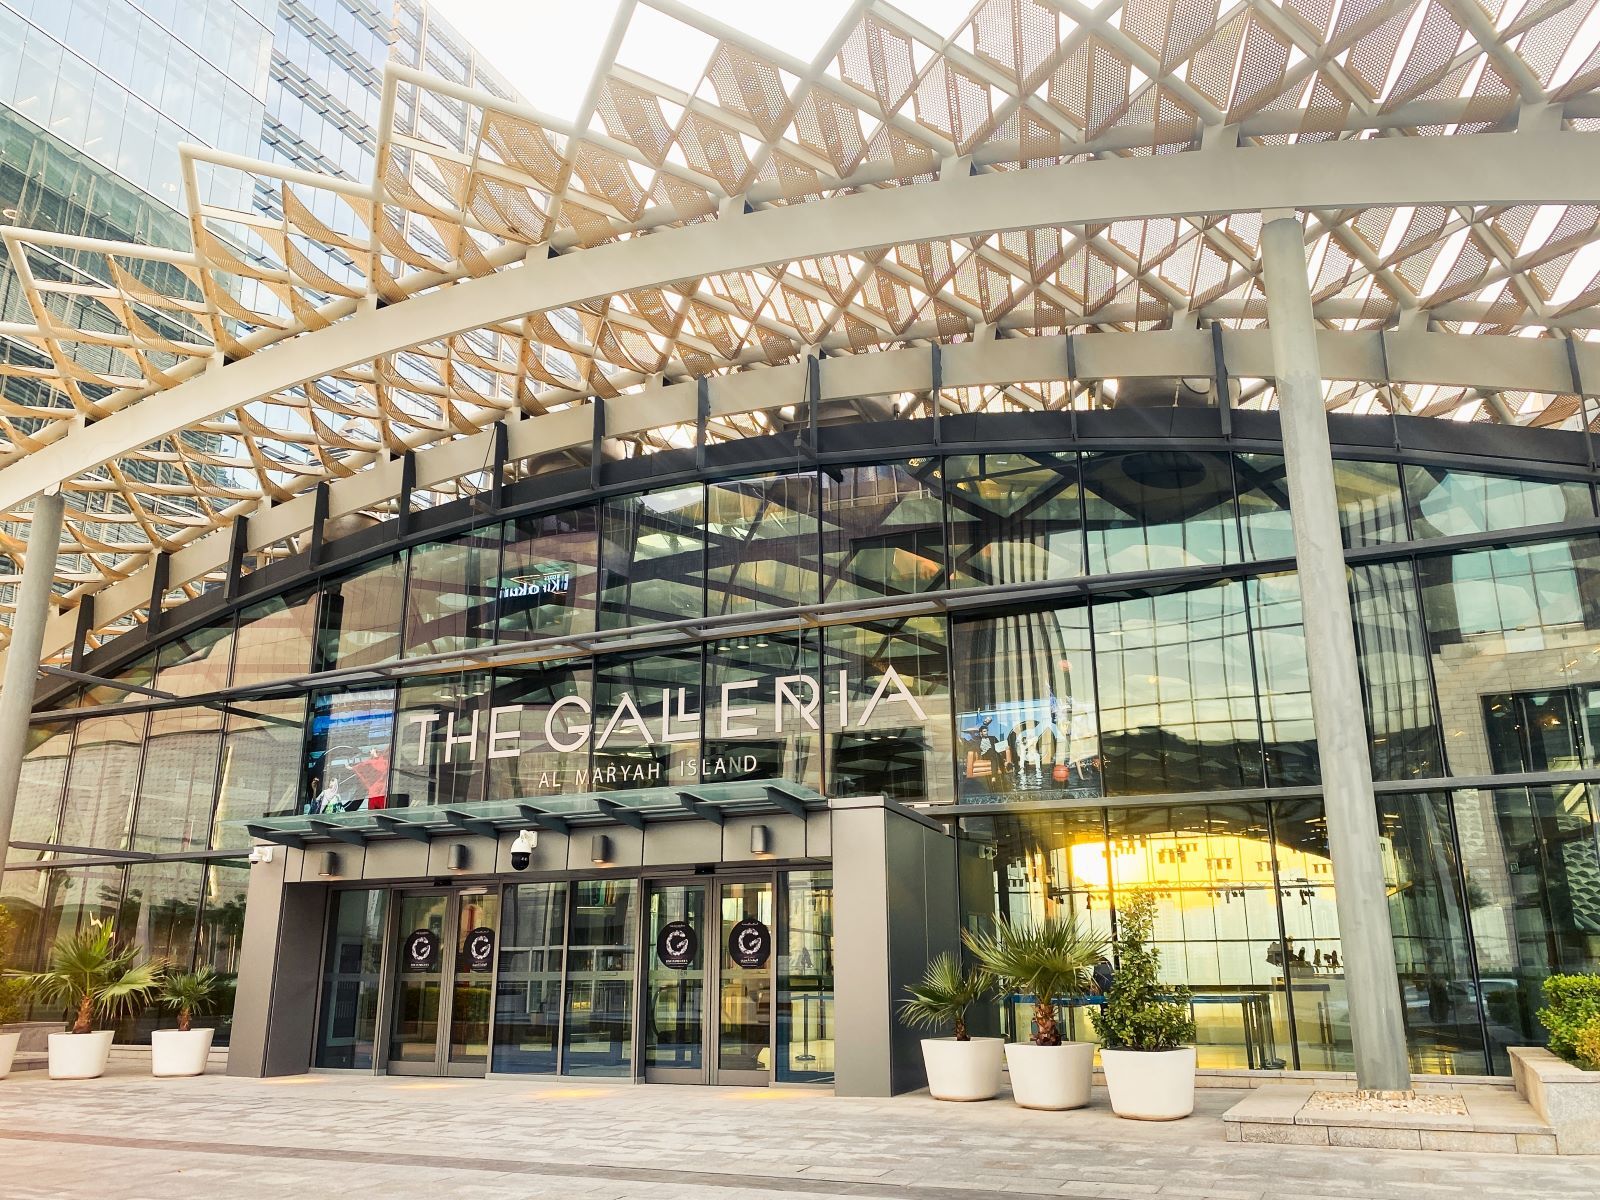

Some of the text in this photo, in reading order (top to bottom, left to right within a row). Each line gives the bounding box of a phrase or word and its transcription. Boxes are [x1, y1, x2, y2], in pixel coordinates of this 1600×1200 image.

[409, 665, 928, 766] THE GALLERIA
[538, 754, 758, 789] AL MARYAH ISLAND
